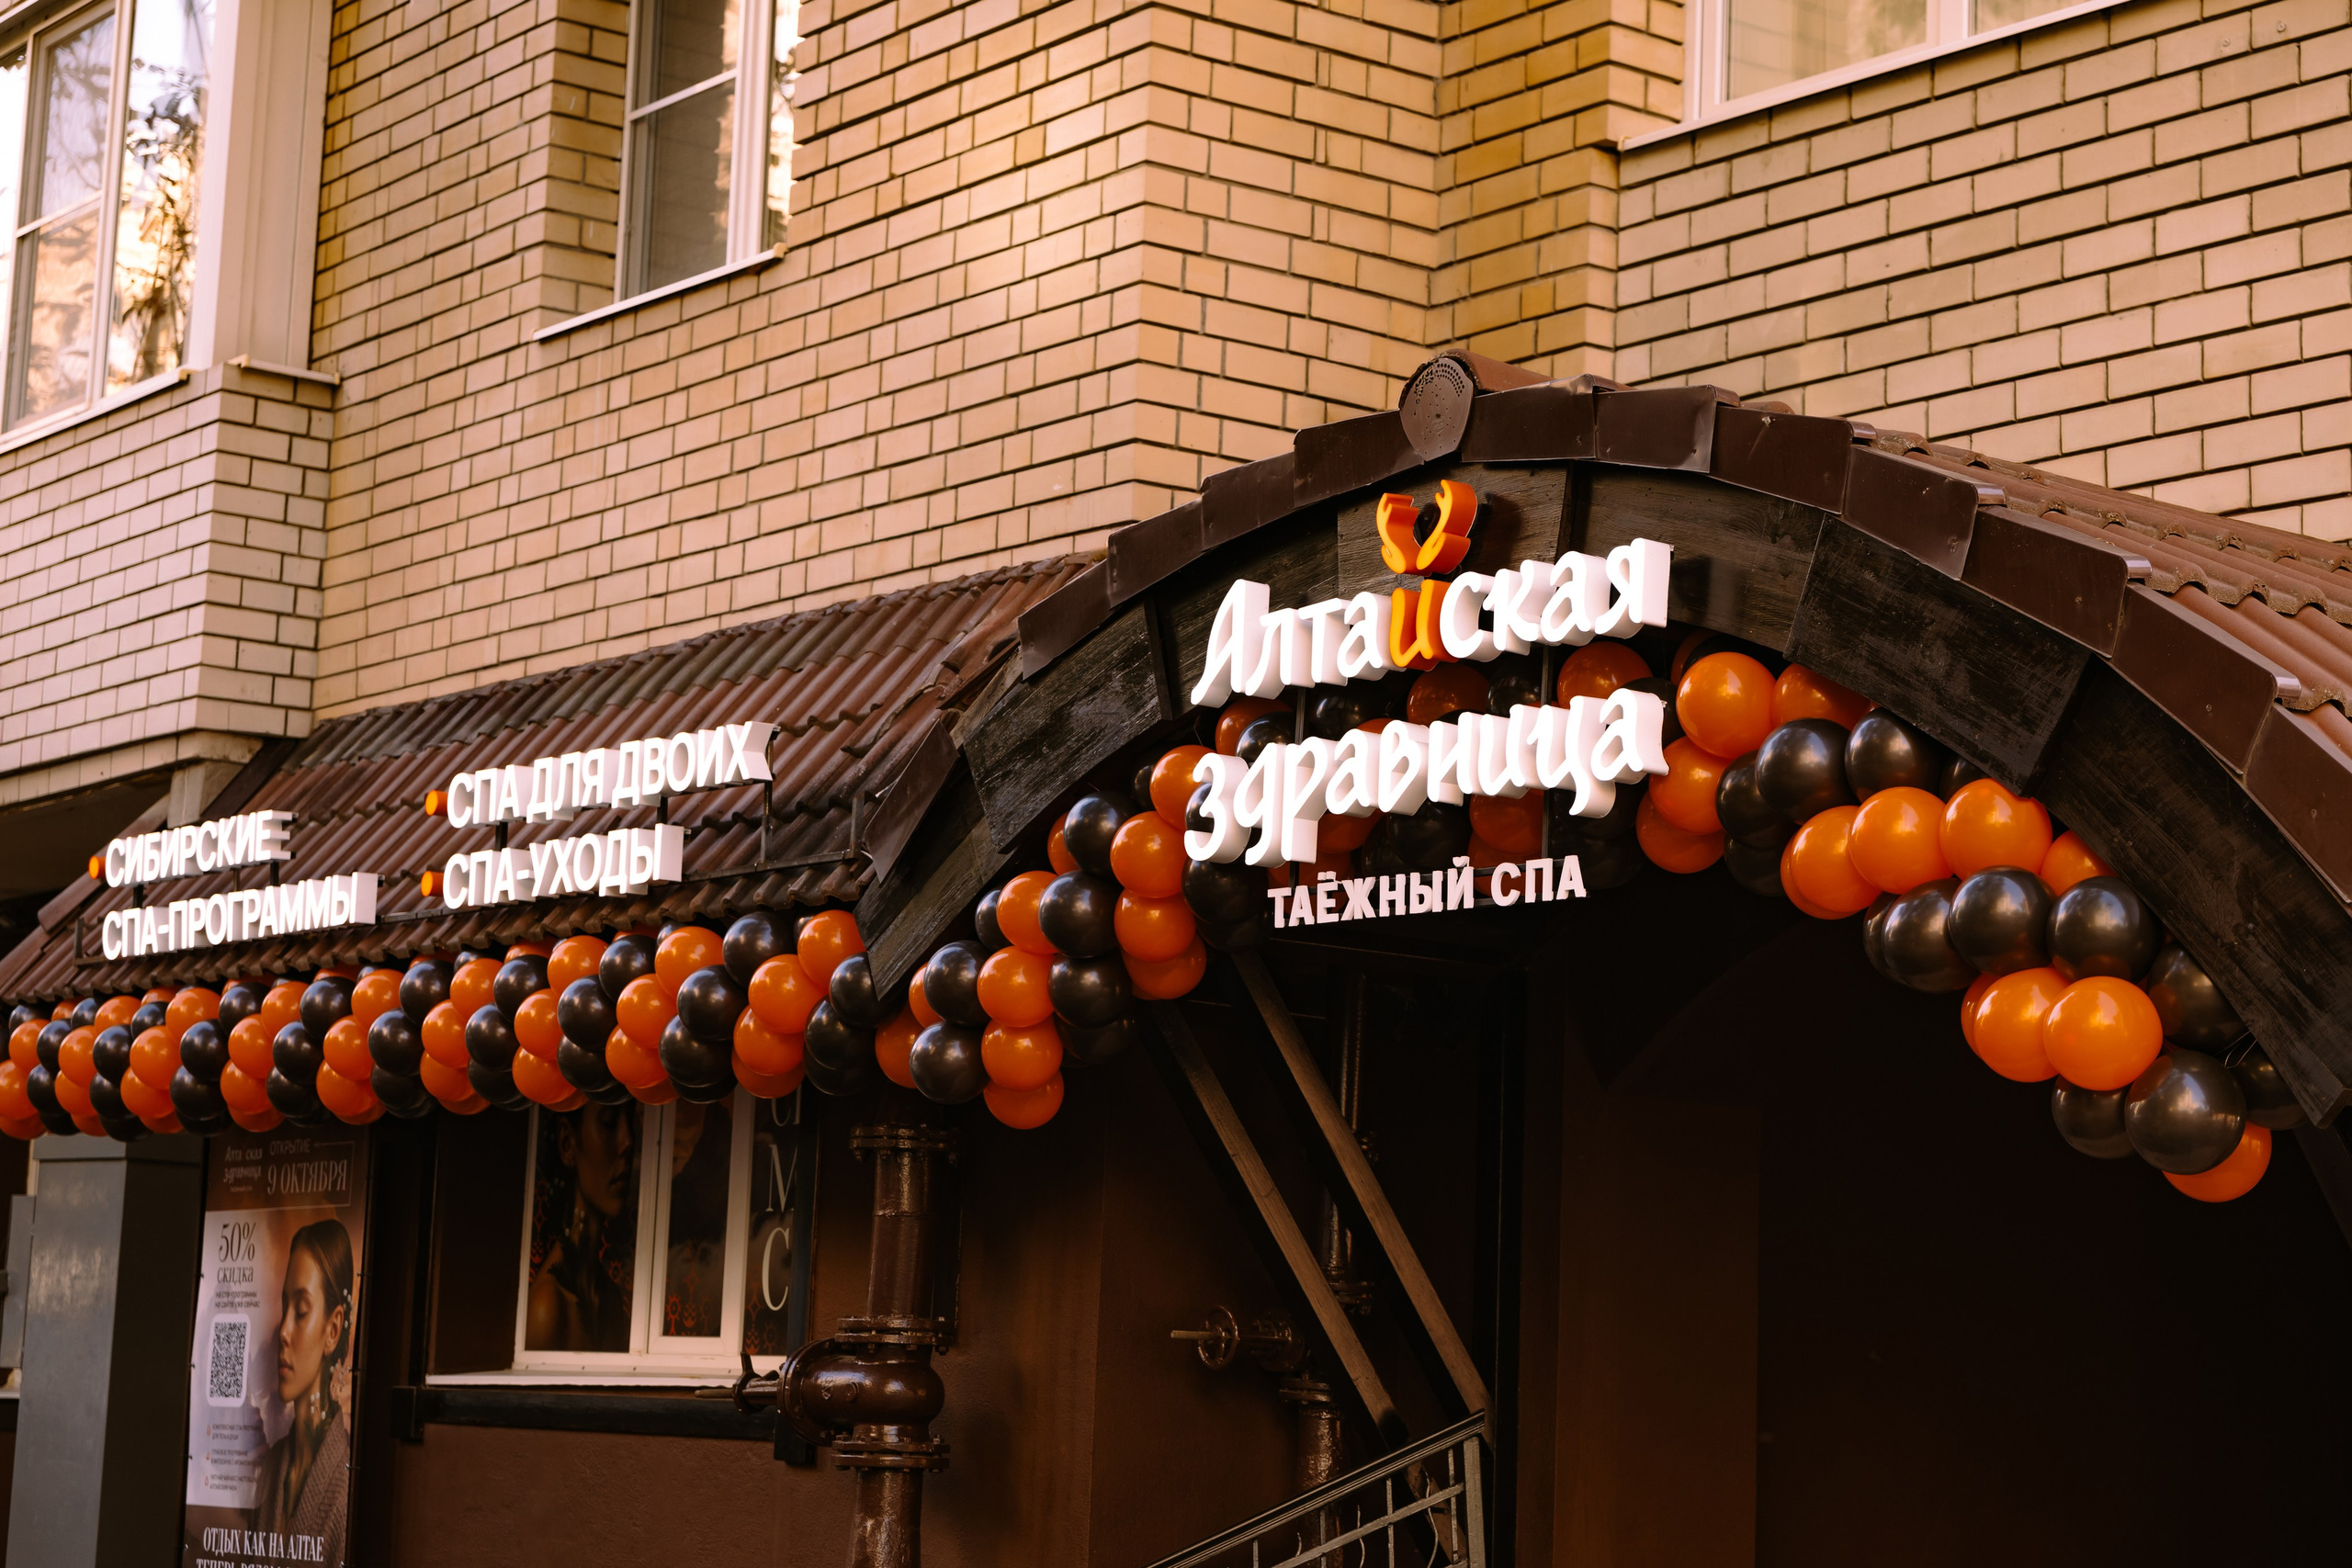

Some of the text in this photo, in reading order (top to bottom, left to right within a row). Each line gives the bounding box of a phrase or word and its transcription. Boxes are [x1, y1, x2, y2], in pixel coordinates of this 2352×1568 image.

[1192, 479, 1670, 706] Алтайская
[447, 721, 770, 829] СПА ДЛЯ ДВОИХ
[105, 809, 287, 888] СИБИРСКИЕ
[442, 823, 675, 910] СПА-УХОДЫ
[102, 873, 371, 961] СПА-ПРОГРАММЫ
[1267, 855, 1587, 929] ТАЁЖНЫЙ СПА
[267, 1159, 348, 1196] 9 ОКТЯБРЯ
[269, 1138, 312, 1156] ОТКРЫТИЕ
[219, 1222, 256, 1263] 50%
[203, 1527, 324, 1562] ОТДЫХ КАК НА АЛТАЕ
